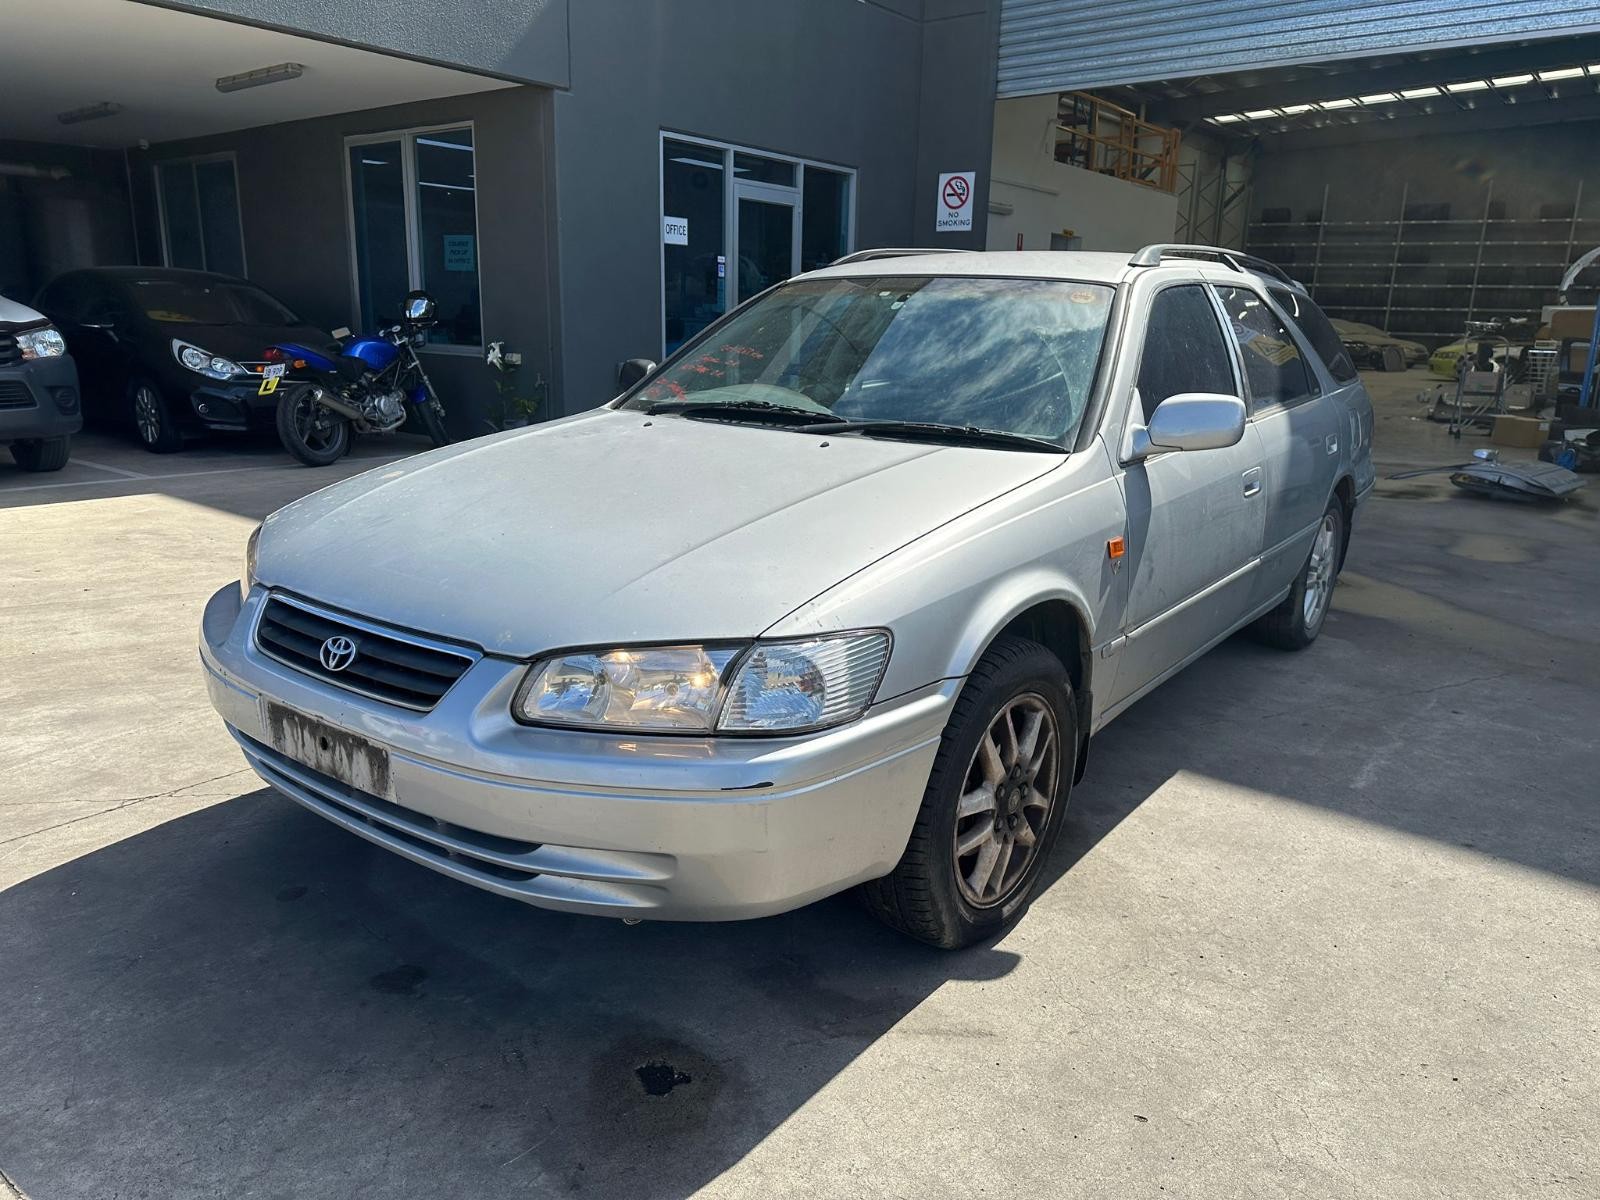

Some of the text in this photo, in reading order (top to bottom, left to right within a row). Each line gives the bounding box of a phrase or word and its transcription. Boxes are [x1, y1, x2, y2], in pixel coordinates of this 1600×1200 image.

[937, 219, 971, 227] SMOKING
[665, 223, 687, 236] OFFICE
[263, 380, 272, 392] L
